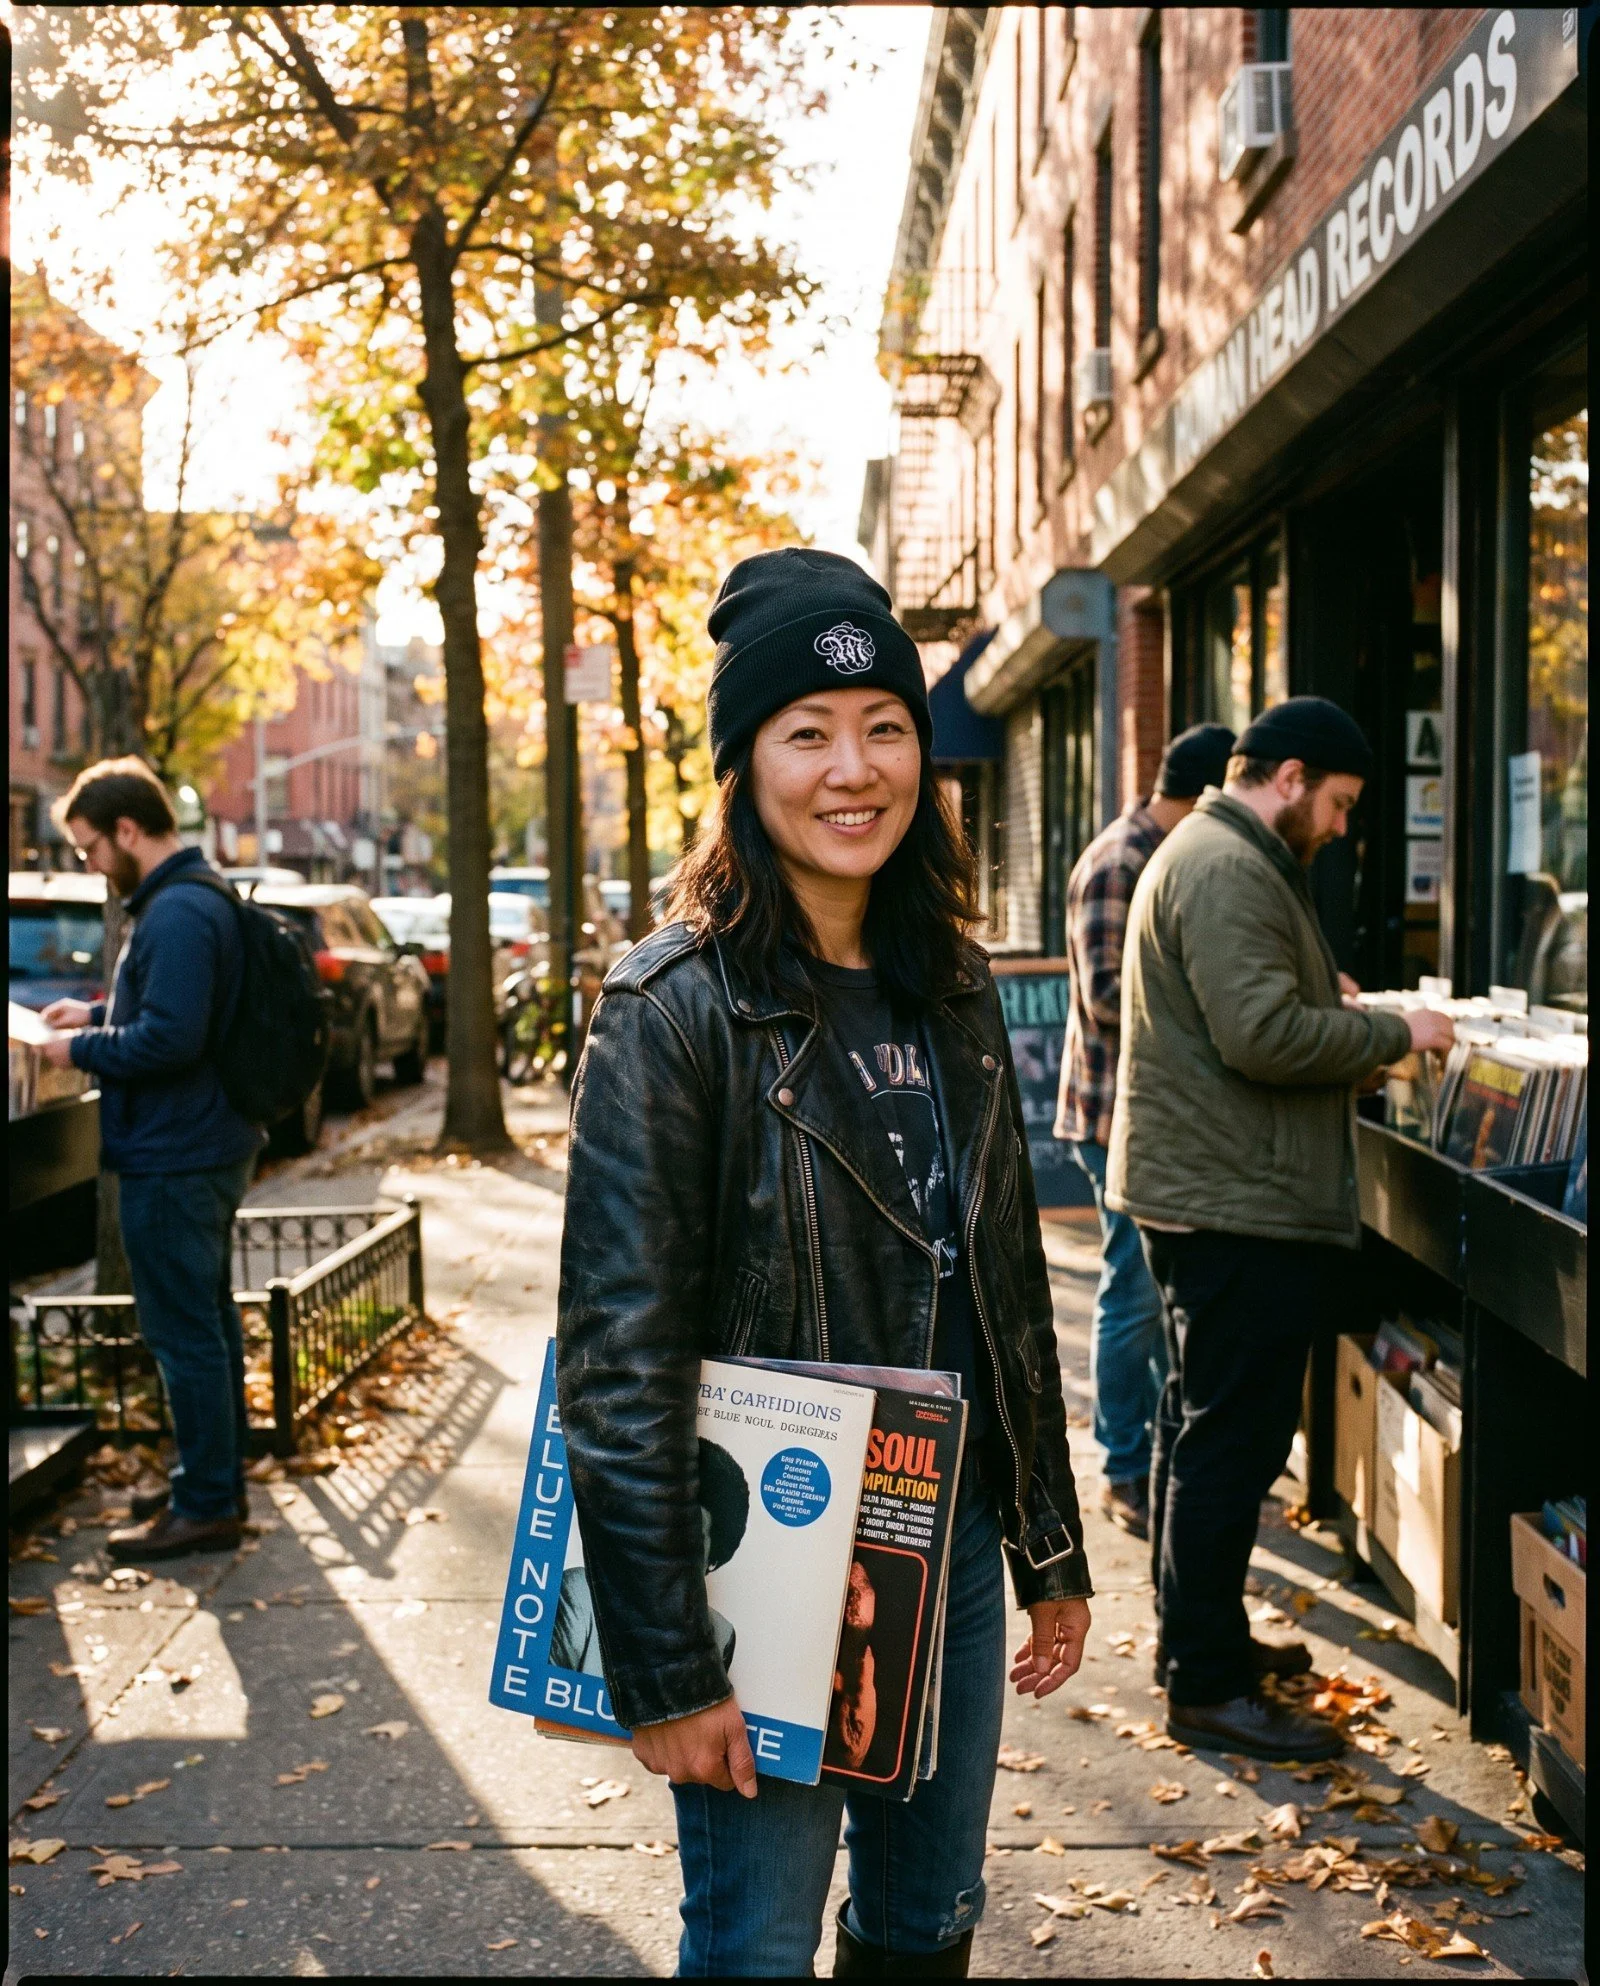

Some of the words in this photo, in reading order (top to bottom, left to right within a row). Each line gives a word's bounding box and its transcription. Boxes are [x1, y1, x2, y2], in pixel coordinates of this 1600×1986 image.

[1250, 247, 1320, 393] HEAD
[1326, 9, 1517, 313] RECORDS
[1416, 717, 1441, 757] A
[713, 1409, 741, 1423] BLUE
[865, 1428, 941, 1480] SOUL
[503, 1557, 550, 1697] NOTE
